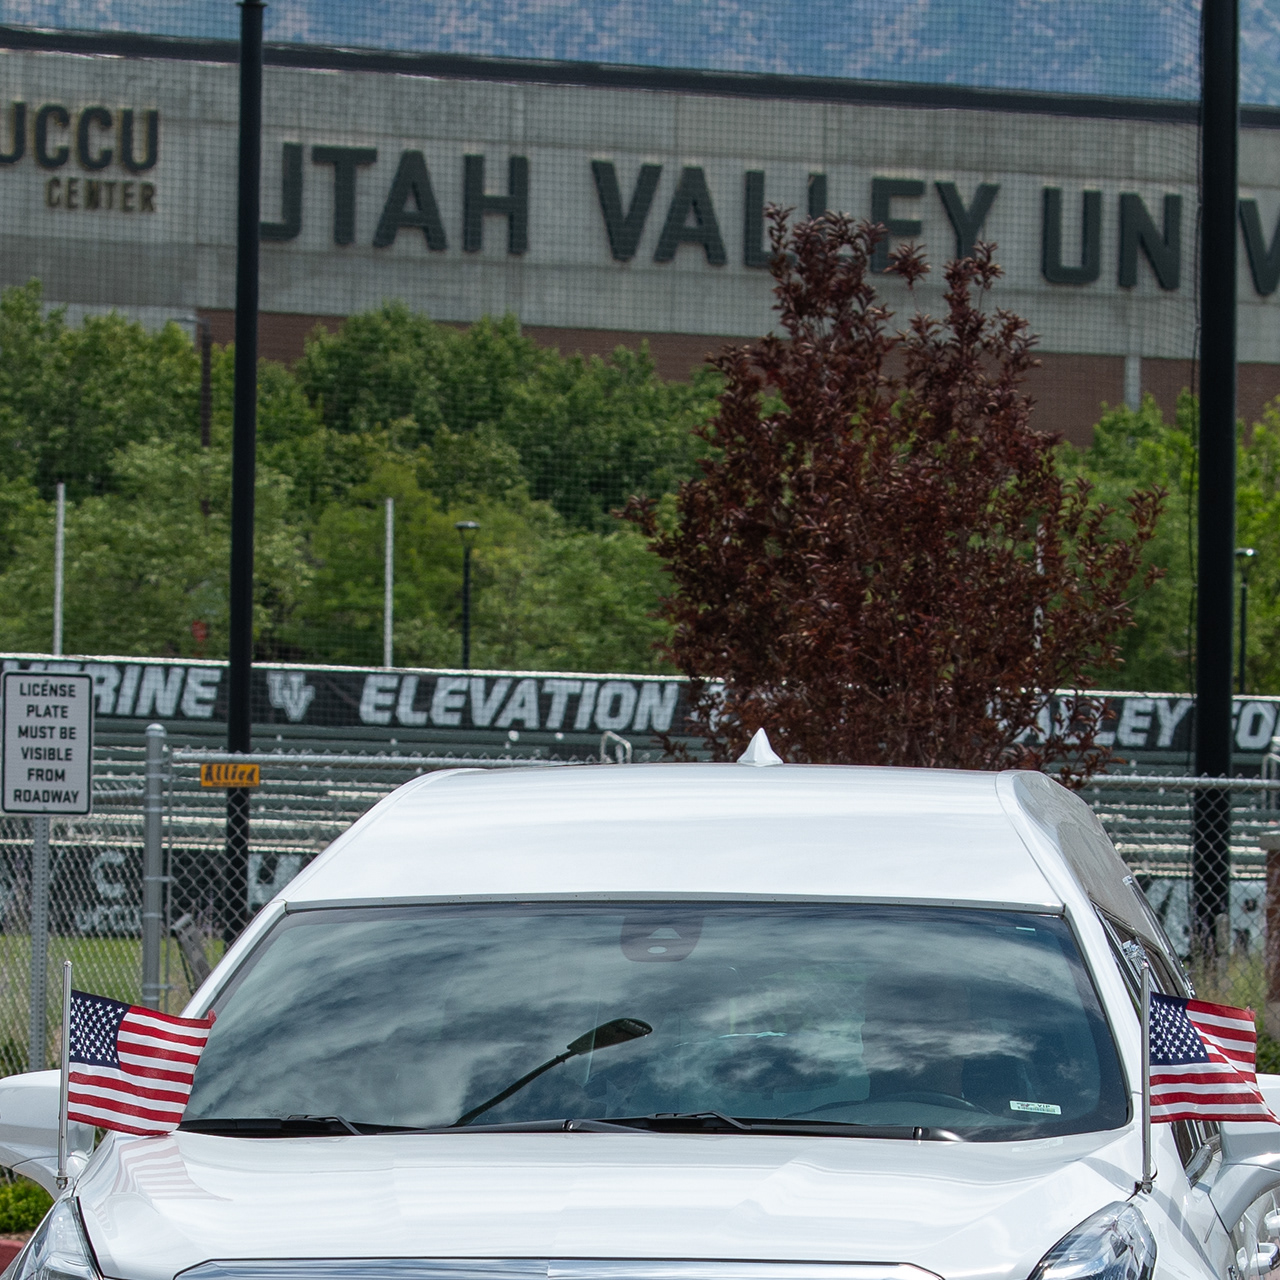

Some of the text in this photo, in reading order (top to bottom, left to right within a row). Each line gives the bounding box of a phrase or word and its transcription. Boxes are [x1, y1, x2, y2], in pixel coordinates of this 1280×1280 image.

[46, 176, 156, 213] CENTER
[20, 683, 76, 698] LICENSE
[359, 673, 679, 733] ELEVATION
[26, 704, 69, 719] PLATE
[18, 726, 76, 740] MUST BE
[21, 747, 73, 761] VISIBLE
[27, 768, 66, 782] FROM
[13, 789, 80, 804] ROADWAY
